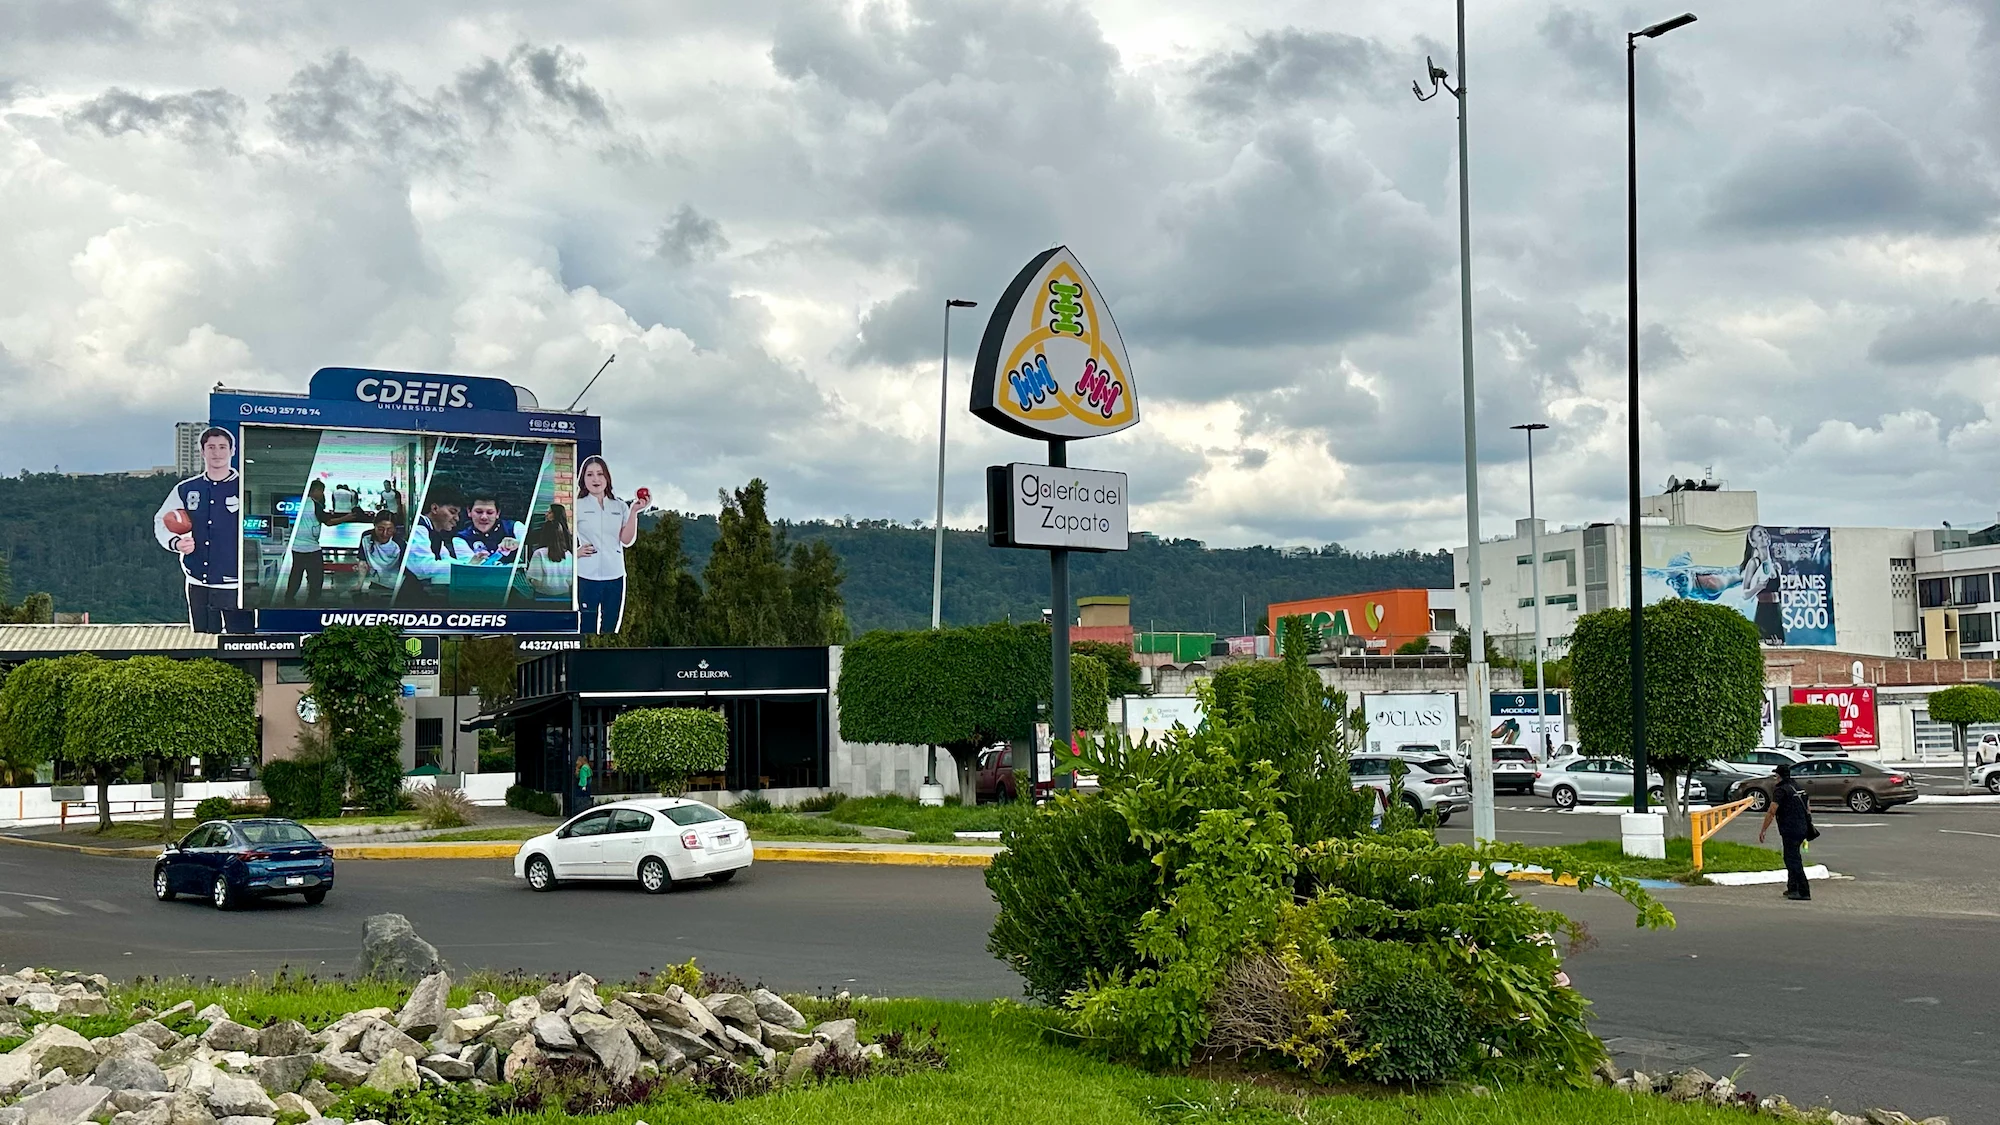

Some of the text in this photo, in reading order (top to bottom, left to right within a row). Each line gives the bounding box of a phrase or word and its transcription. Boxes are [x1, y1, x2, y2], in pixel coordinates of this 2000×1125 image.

[254, 405, 277, 414] (443)
[278, 407, 295, 415] 257
[377, 404, 445, 413] UNIVERSIDAD
[1021, 474, 1121, 506] galería del
[1041, 505, 1110, 534] Zapato
[1780, 574, 1826, 589] PLANES
[1781, 591, 1827, 607] DESDE
[320, 613, 507, 627] UNIVERSIDAD CDEFIS
[1781, 606, 1829, 632] $600
[224, 640, 295, 651] naranti.com
[519, 640, 581, 650] 4432741515
[676, 669, 730, 679] CAFÉ EUROPA
[1531, 724, 1560, 734] Loal C
